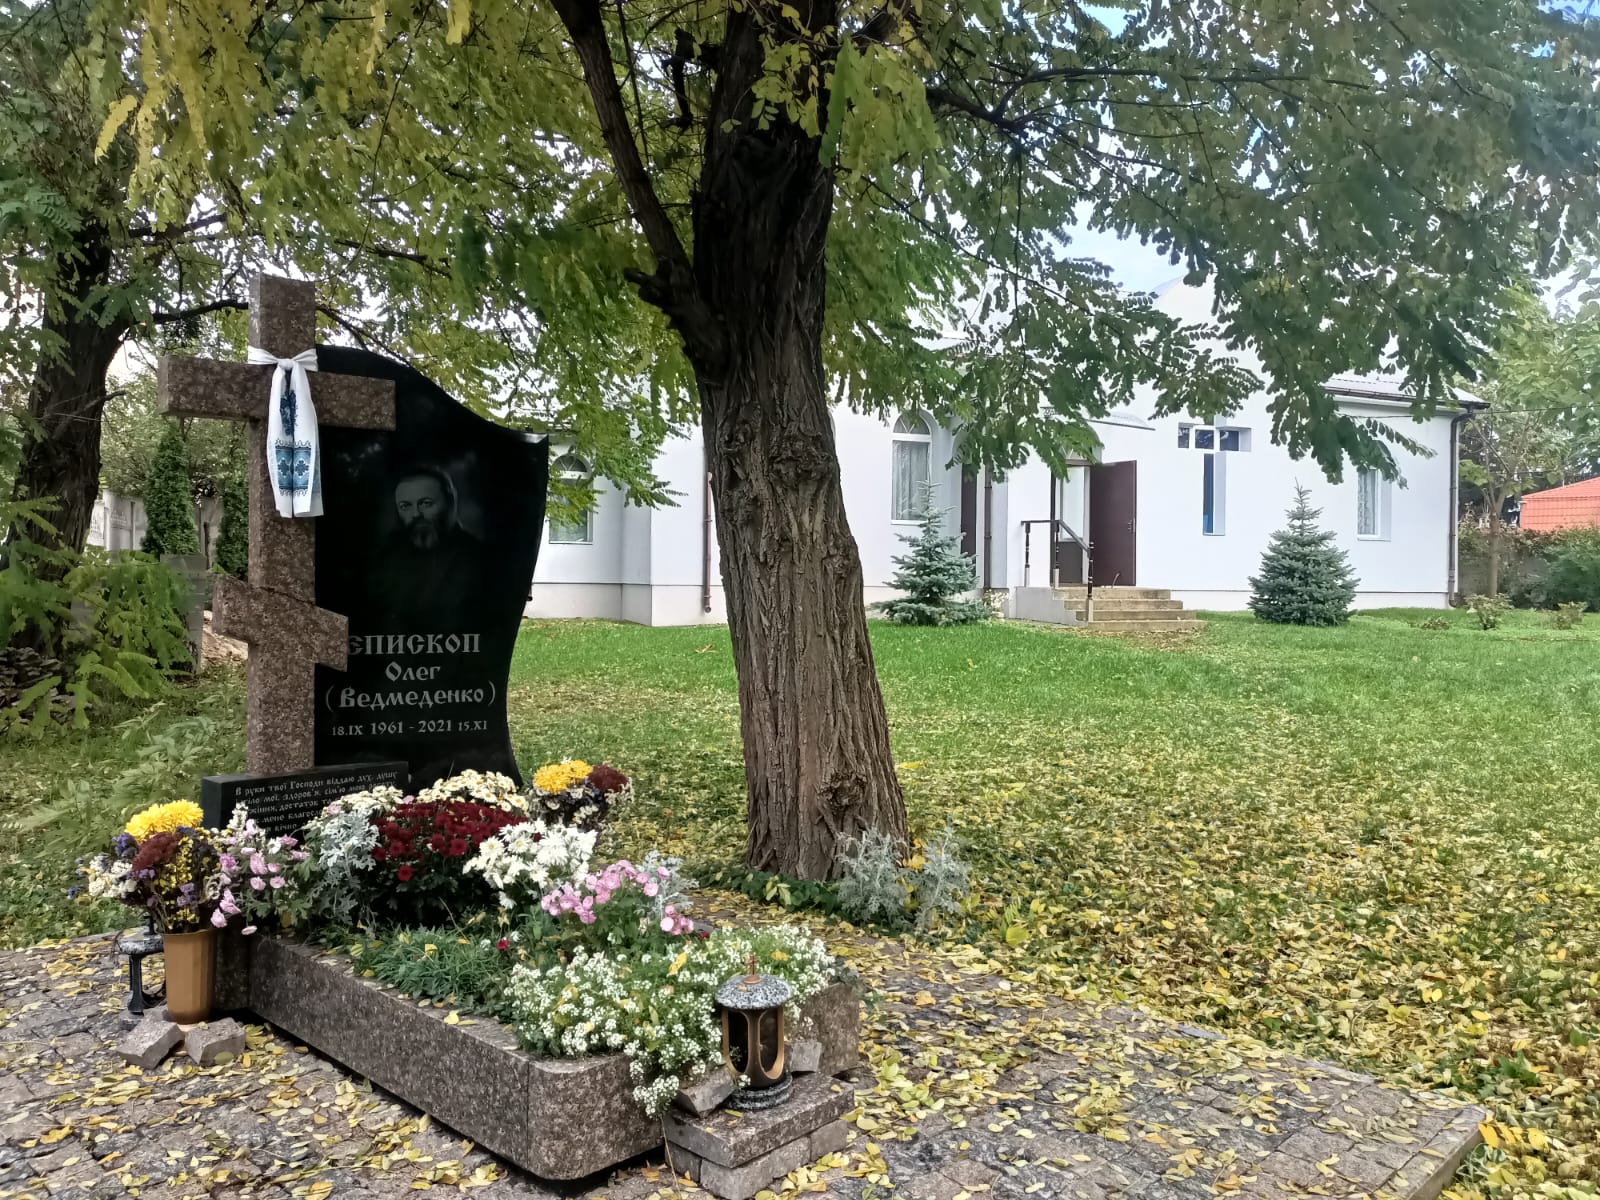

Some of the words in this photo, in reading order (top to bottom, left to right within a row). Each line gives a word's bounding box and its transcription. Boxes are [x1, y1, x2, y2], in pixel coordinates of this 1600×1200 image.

[385, 661, 441, 682] Олег
[371, 721, 403, 735] 1961
[418, 719, 452, 733] 2021
[245, 786, 265, 797] руки
[268, 782, 288, 792] твої
[290, 780, 323, 790] Господи
[326, 776, 355, 785] віддаю
